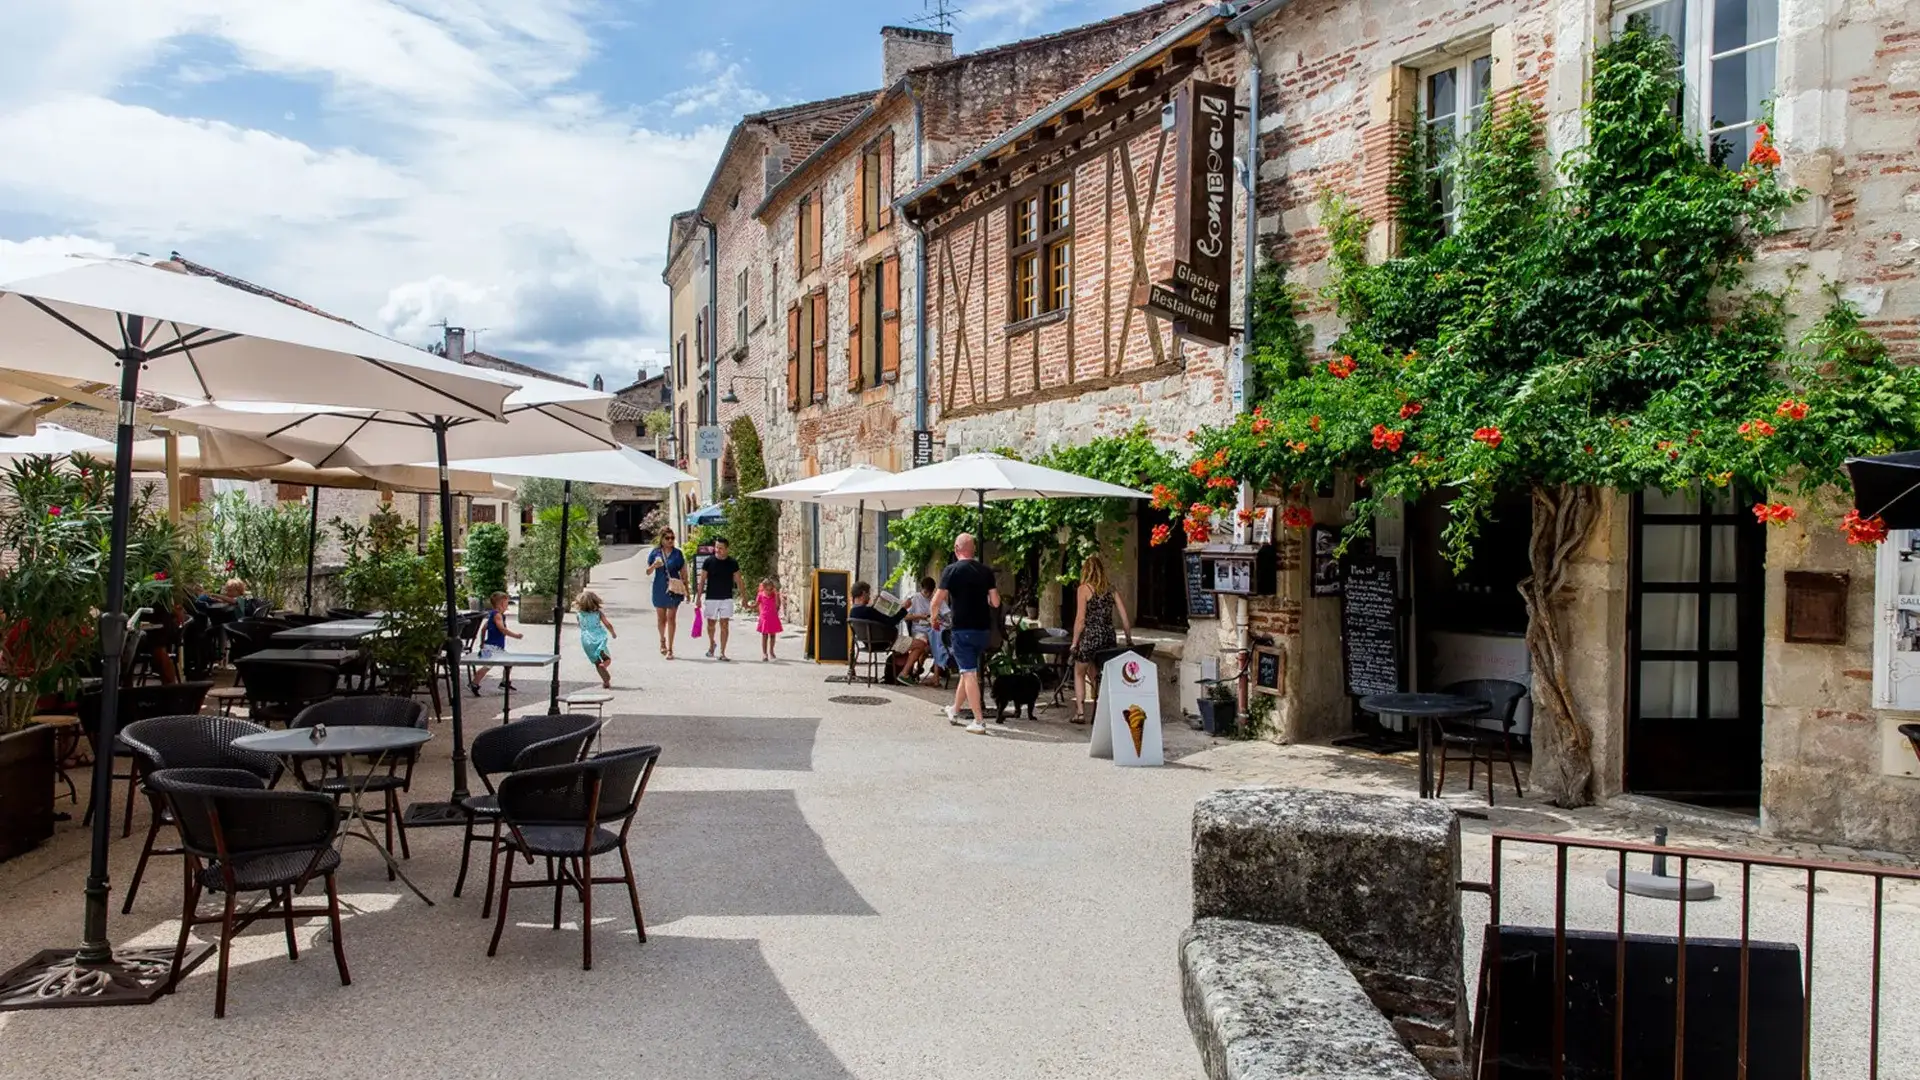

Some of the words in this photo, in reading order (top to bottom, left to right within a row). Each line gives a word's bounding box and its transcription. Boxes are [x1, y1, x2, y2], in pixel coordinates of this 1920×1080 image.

[1177, 264, 1220, 293] Glacier
[1152, 288, 1214, 326] Restaurant
[1191, 287, 1217, 309] Café
